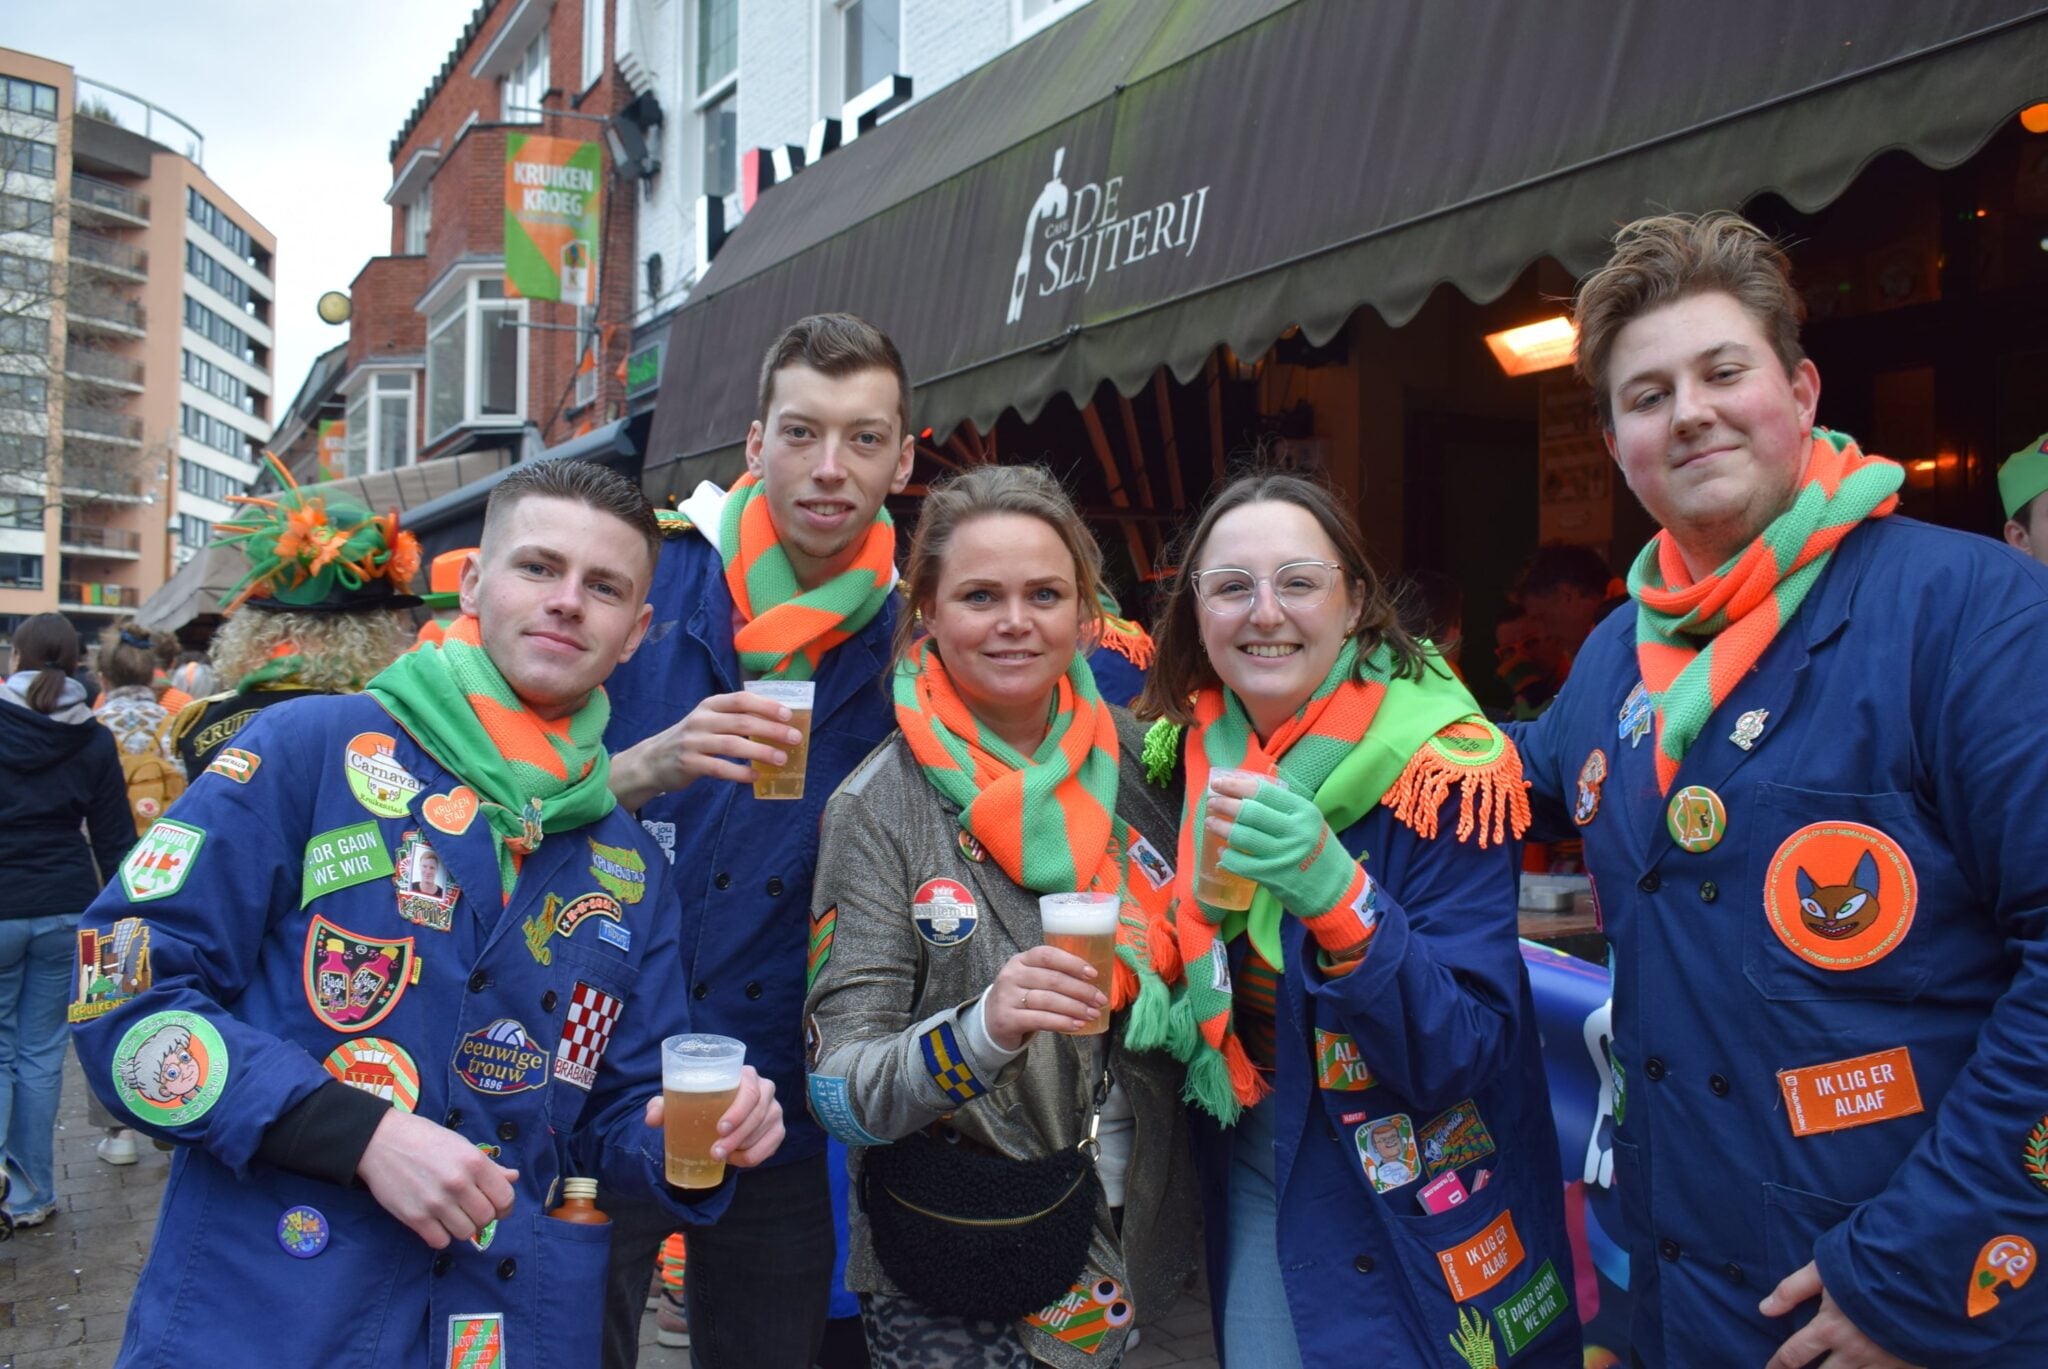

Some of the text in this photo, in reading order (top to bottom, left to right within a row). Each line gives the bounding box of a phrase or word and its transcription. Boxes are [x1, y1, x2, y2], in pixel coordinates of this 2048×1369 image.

[513, 162, 593, 191] KRUIKEN
[523, 189, 583, 215] KROEG
[1066, 176, 1123, 241] DE
[1039, 186, 1210, 296] SLIJTERIJ
[351, 753, 420, 791] Carnaval
[433, 796, 470, 816] KRUIKEN
[443, 808, 466, 824] STAD
[308, 831, 378, 865] OR GAON
[312, 855, 373, 886] WE WIR
[463, 1040, 543, 1070] eeuwige
[468, 1056, 525, 1083] trouw
[478, 1077, 503, 1091] 1896
[1342, 1061, 1369, 1083] YO
[1815, 1063, 1895, 1096] IK LIG ER
[1835, 1089, 1886, 1117] ALAAF
[1465, 1225, 1508, 1266] IK LIG ER
[1482, 1248, 1509, 1280] ALAAF
[1510, 1270, 1556, 1322] DAOR GAON
[1523, 1295, 1557, 1333] WE WIR
